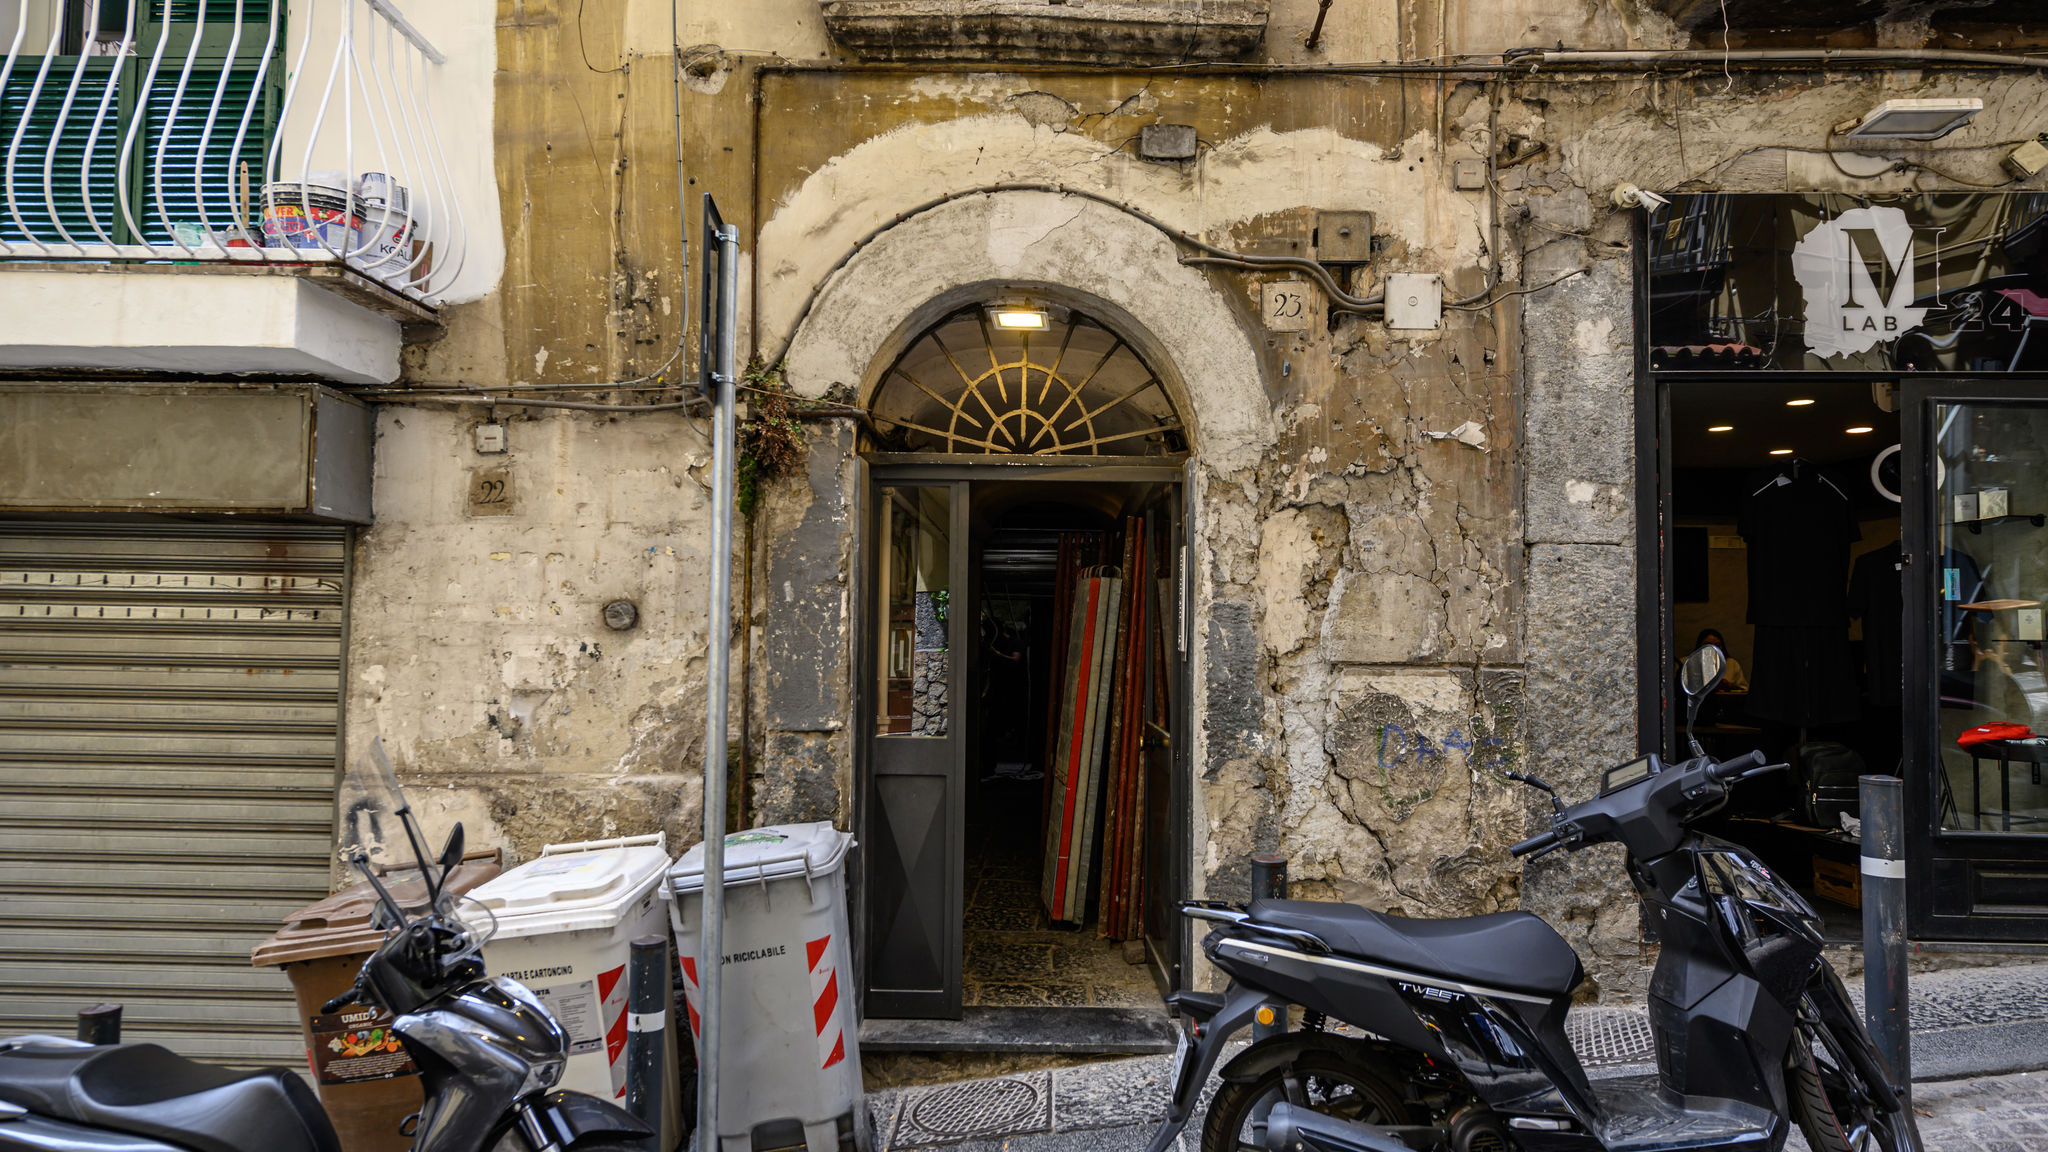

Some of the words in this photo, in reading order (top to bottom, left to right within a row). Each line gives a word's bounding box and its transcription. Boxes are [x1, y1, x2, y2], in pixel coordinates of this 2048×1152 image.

[1950, 292, 2026, 332] 24
[1843, 316, 1898, 331] LAB
[477, 480, 505, 504] 22
[721, 955, 732, 965] ON
[733, 945, 786, 963] RICICLABILE
[524, 970, 529, 980] E
[529, 965, 573, 979] CARTONCINO
[1399, 982, 1465, 1001] TWEET
